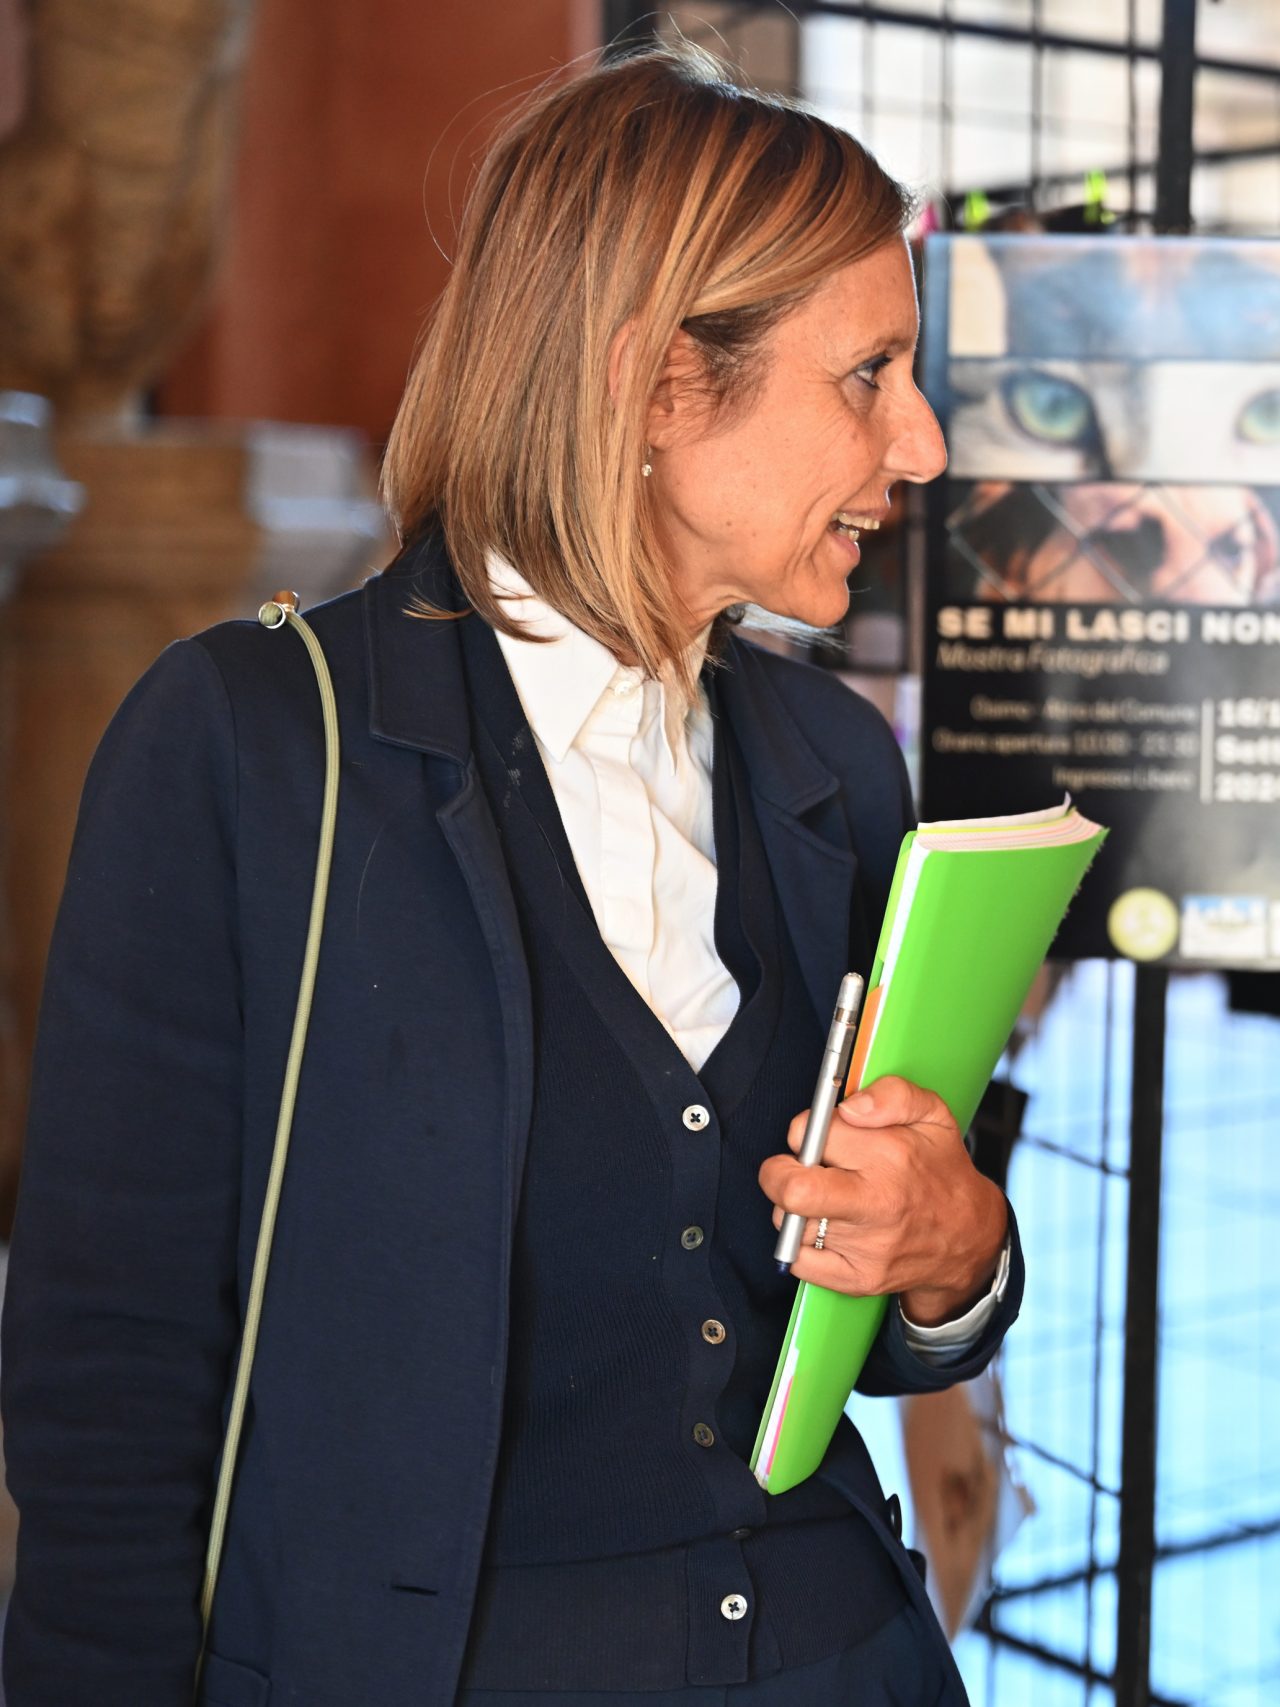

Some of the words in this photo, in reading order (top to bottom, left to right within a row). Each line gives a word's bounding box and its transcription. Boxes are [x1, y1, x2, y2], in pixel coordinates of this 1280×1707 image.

[937, 608, 991, 639] SE
[1003, 608, 1053, 640] MI
[1066, 609, 1190, 642] LASCI
[936, 644, 1027, 671] Mostra
[1028, 645, 1169, 678] Fotografica
